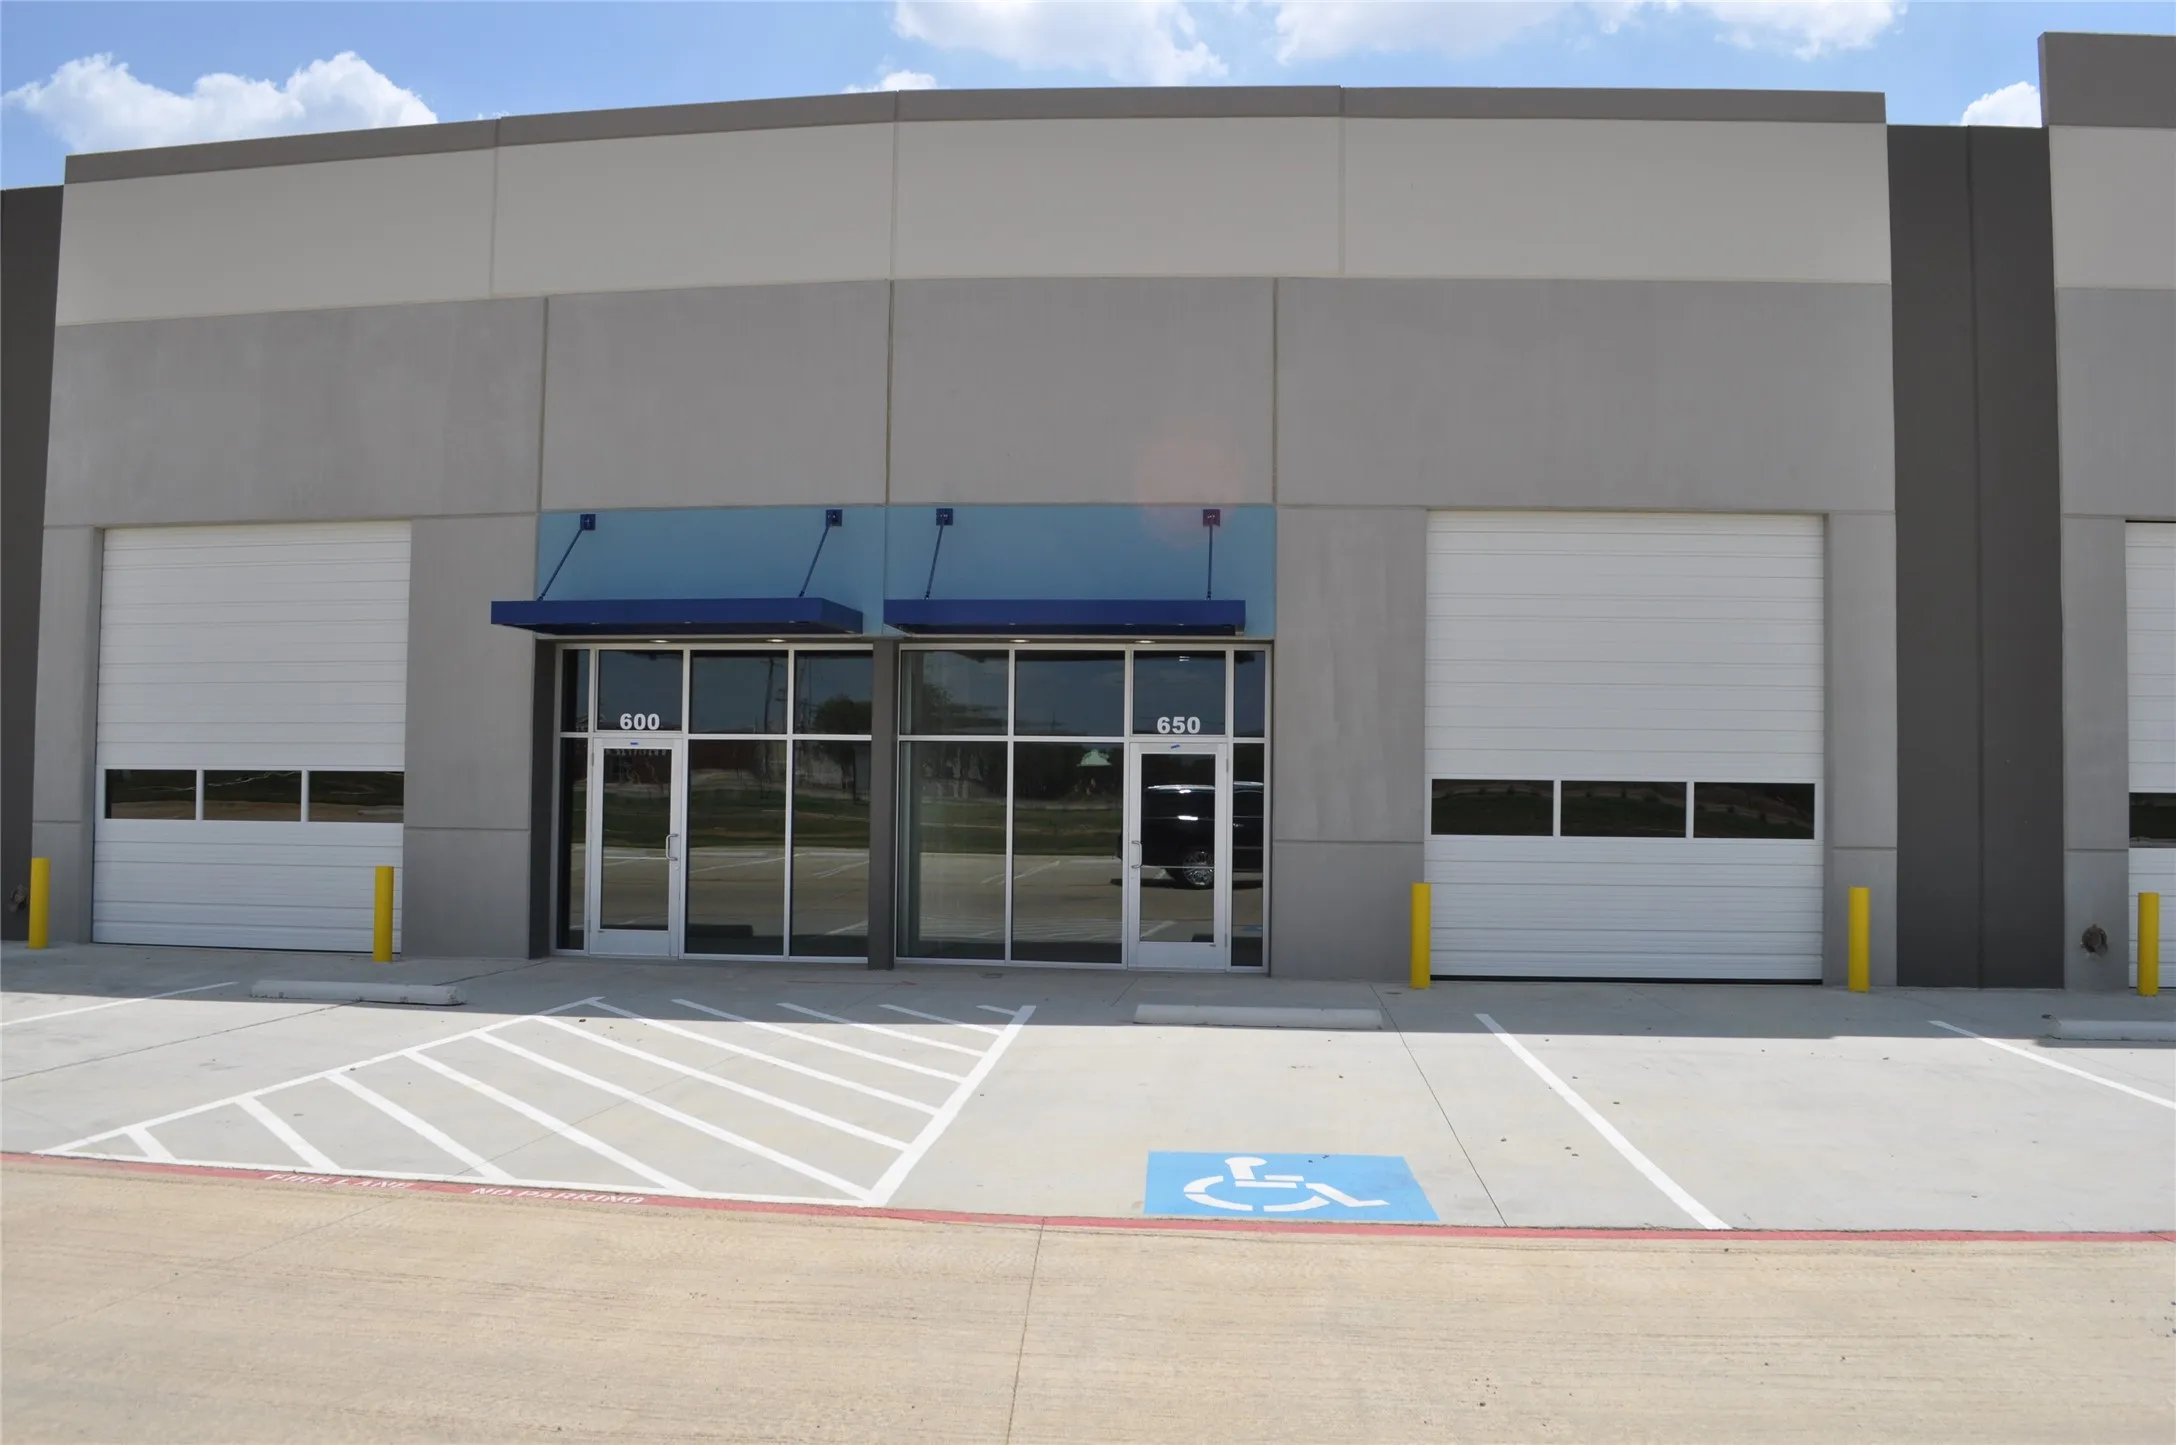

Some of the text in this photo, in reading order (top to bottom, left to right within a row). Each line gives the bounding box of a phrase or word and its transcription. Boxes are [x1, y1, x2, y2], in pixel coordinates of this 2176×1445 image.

[619, 713, 660, 730] 600
[1156, 716, 1201, 734] 650
[265, 1174, 414, 1188] FIRE LANE
[471, 1188, 645, 1204] NO PARKING
